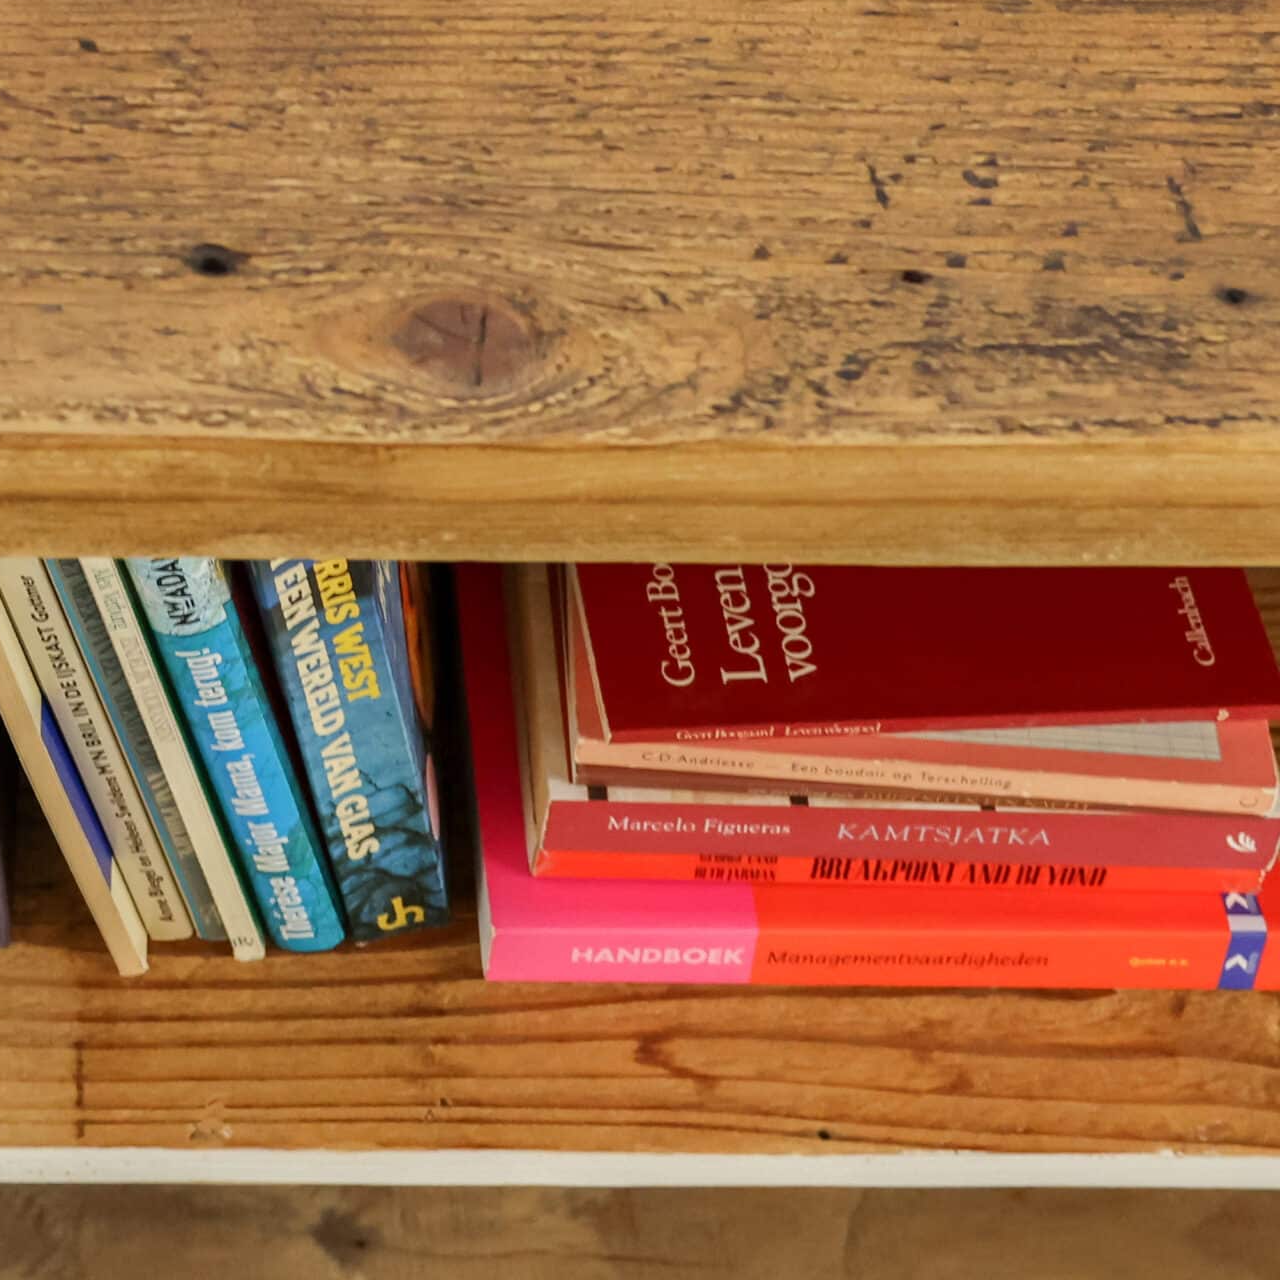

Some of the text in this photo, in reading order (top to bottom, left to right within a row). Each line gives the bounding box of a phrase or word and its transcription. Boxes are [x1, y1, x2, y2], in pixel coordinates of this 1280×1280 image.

[312, 558, 382, 703] RRIS WEST
[646, 562, 696, 688] Geert Bo
[714, 564, 769, 686] Leven
[1168, 575, 1216, 667] Callenbach
[36, 626, 77, 682] IJSKAST
[174, 647, 229, 708] terug!
[60, 679, 82, 700] DE
[69, 699, 91, 719] IN
[273, 561, 381, 862] EEN WERELD VAN GLAS
[78, 717, 103, 749] BRIL
[208, 710, 245, 753] kom
[790, 761, 821, 776] Een
[891, 770, 913, 783] op
[245, 820, 290, 873] Major
[606, 815, 1052, 847] Marcelo Figueras KAMTSJATKA
[809, 856, 1108, 888] BREAKPOINT AND BEYOND
[570, 945, 1050, 969] HANDBOEK Managementvaardigheden
